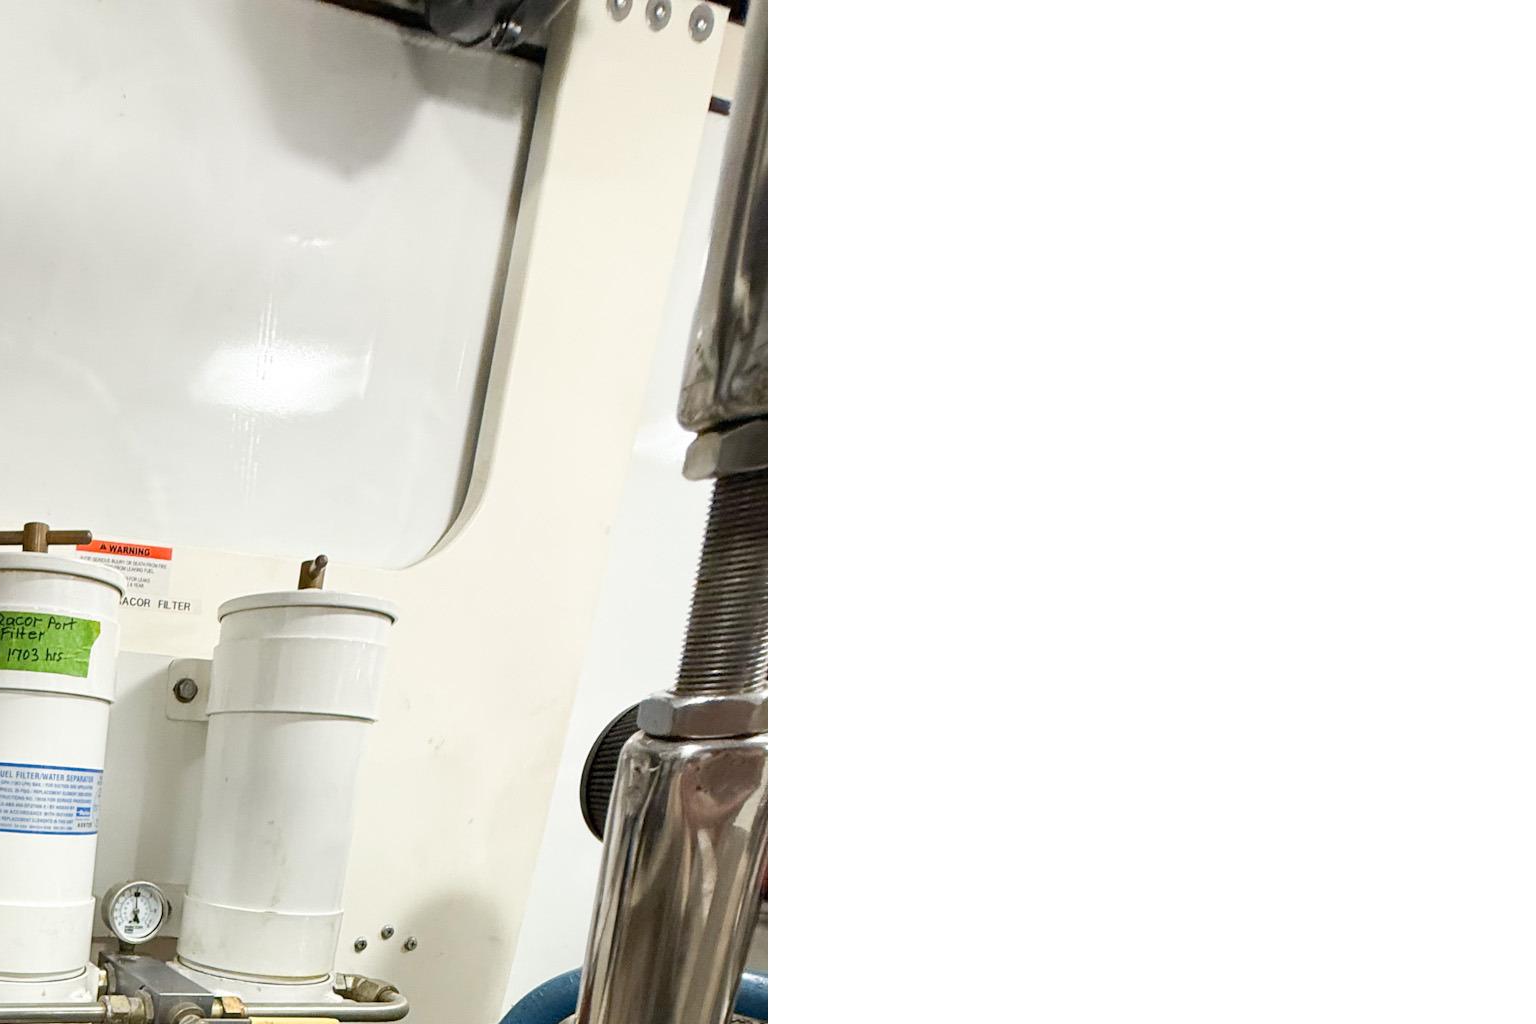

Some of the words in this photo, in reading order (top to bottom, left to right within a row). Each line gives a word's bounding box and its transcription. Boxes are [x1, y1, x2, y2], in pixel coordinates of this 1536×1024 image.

[109, 546, 151, 557] WARNING
[119, 596, 151, 607] ACOR
[157, 599, 191, 611] FILTER
[47, 617, 77, 630] Port
[0, 627, 45, 641] Filter
[7, 648, 40, 662] 1703
[45, 648, 64, 662] hrs
